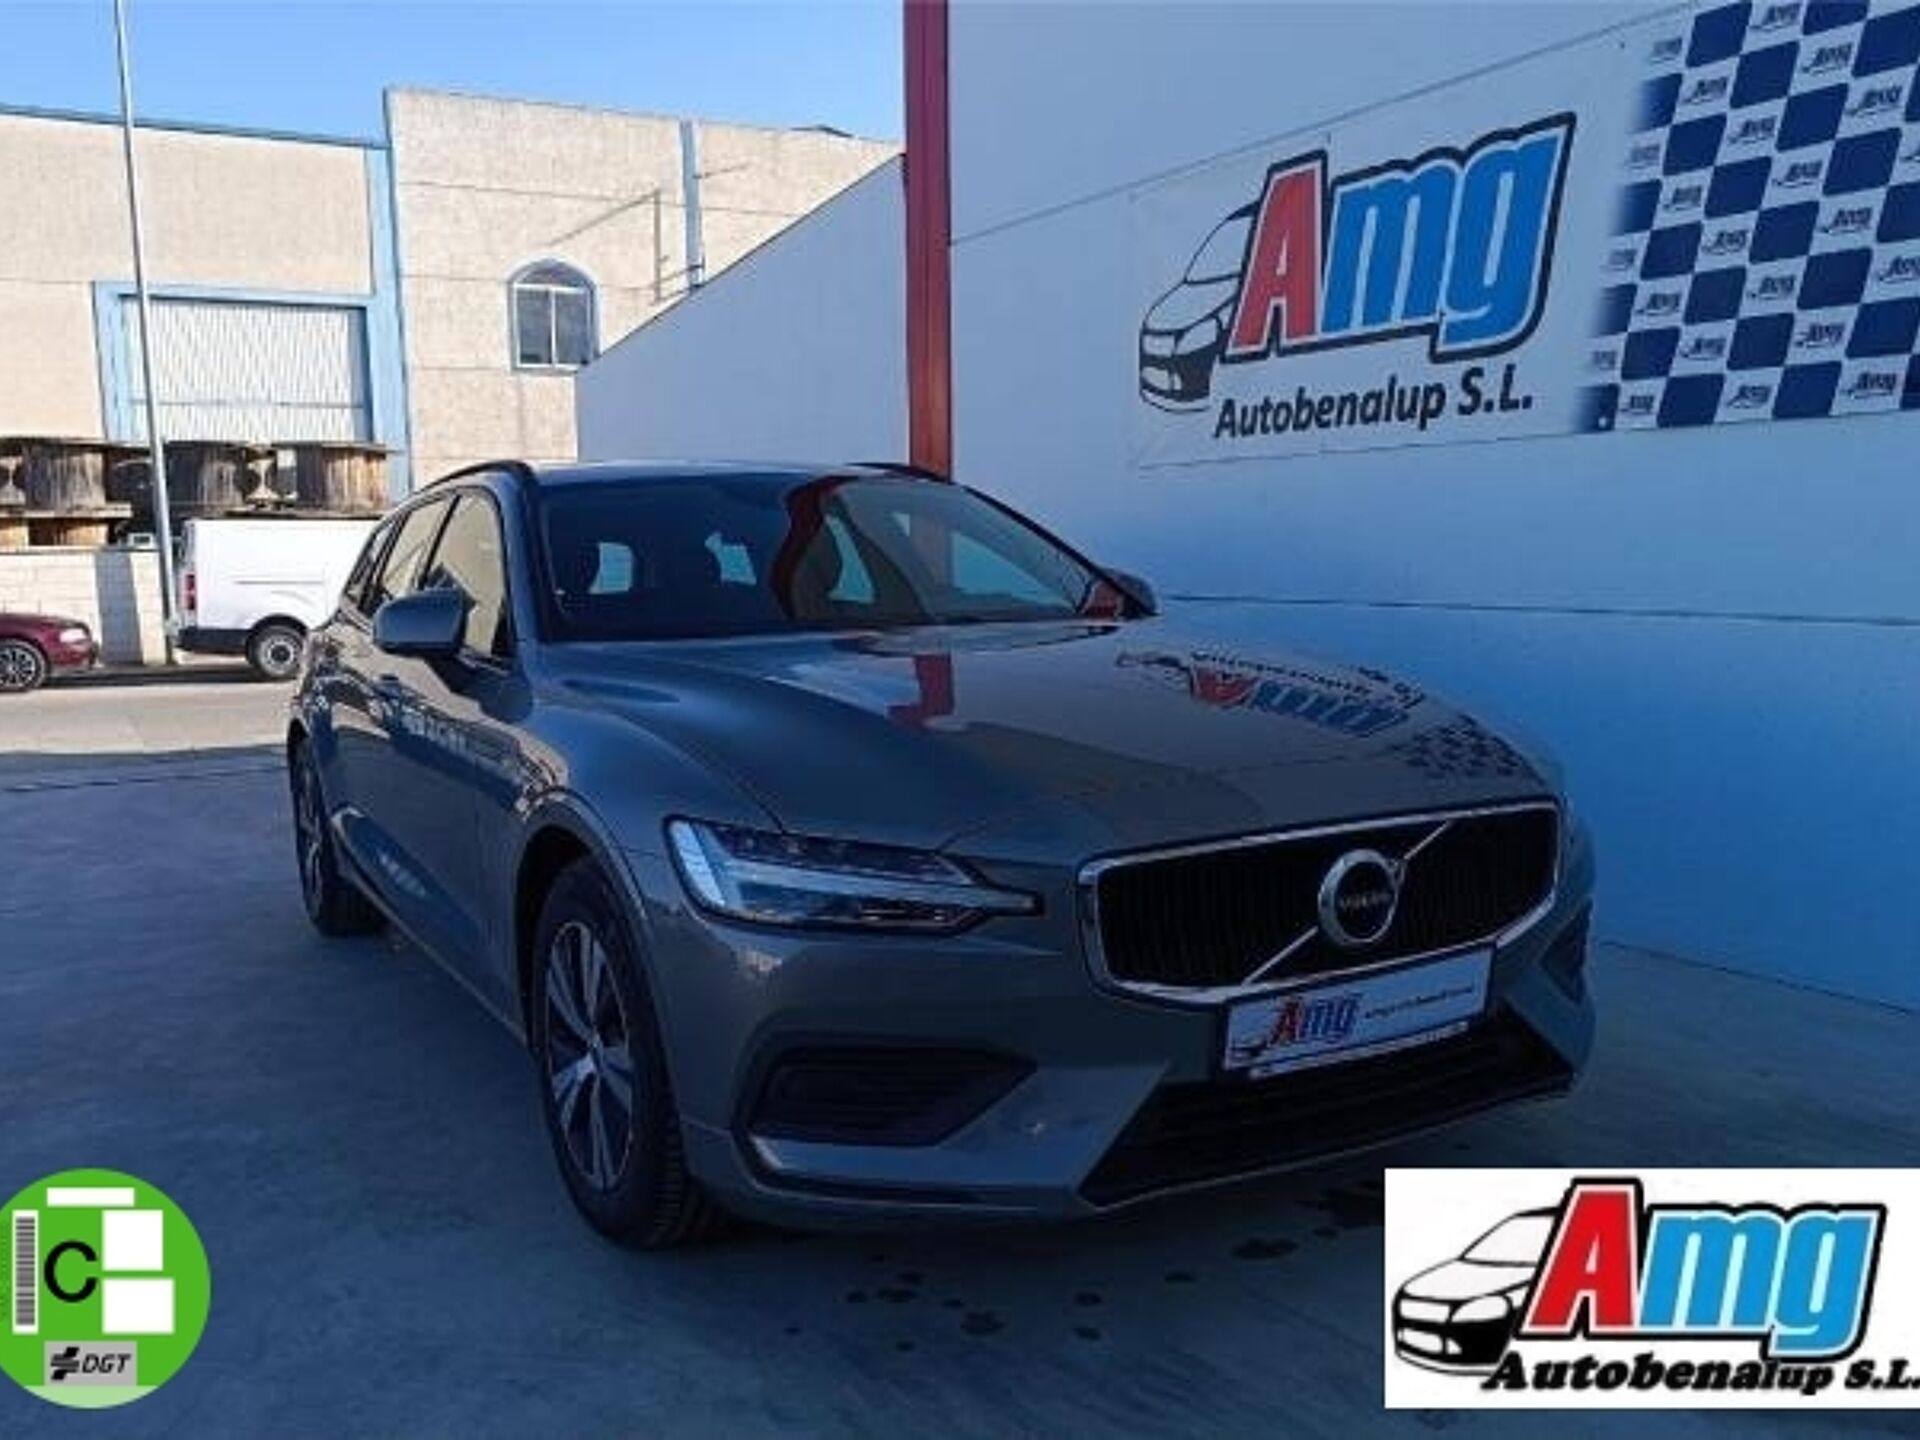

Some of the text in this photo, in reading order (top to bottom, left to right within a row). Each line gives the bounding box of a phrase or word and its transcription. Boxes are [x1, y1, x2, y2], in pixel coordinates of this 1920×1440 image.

[1219, 111, 1577, 364] Amg
[1213, 362, 1534, 438] Autobenalup S.L.
